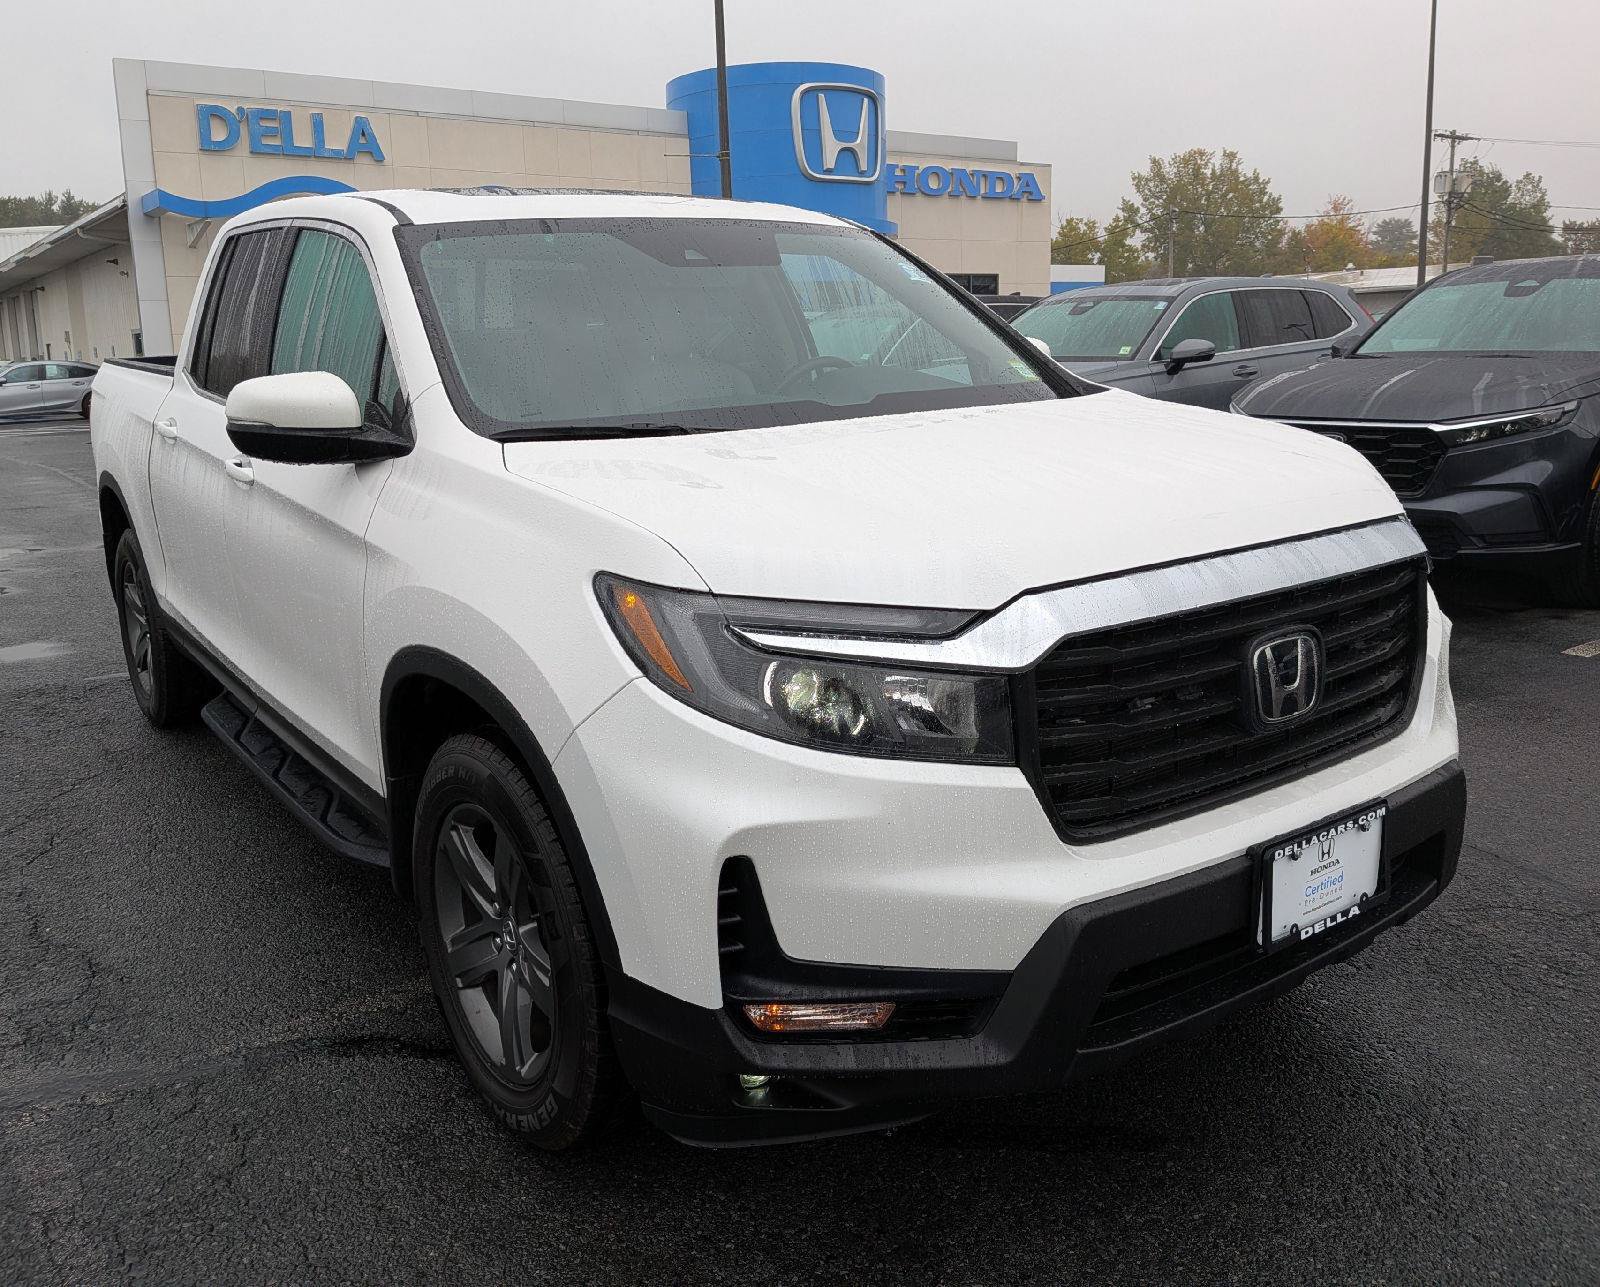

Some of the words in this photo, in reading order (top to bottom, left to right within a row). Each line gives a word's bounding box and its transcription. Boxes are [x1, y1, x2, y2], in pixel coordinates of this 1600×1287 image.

[196, 103, 386, 162] D'ELLA
[886, 163, 1046, 201] HONDA
[1274, 806, 1387, 861] DELLACARS.COM
[1305, 870, 1344, 897] Certified
[1310, 859, 1341, 877] HONDA
[1300, 904, 1361, 940] DELLA
